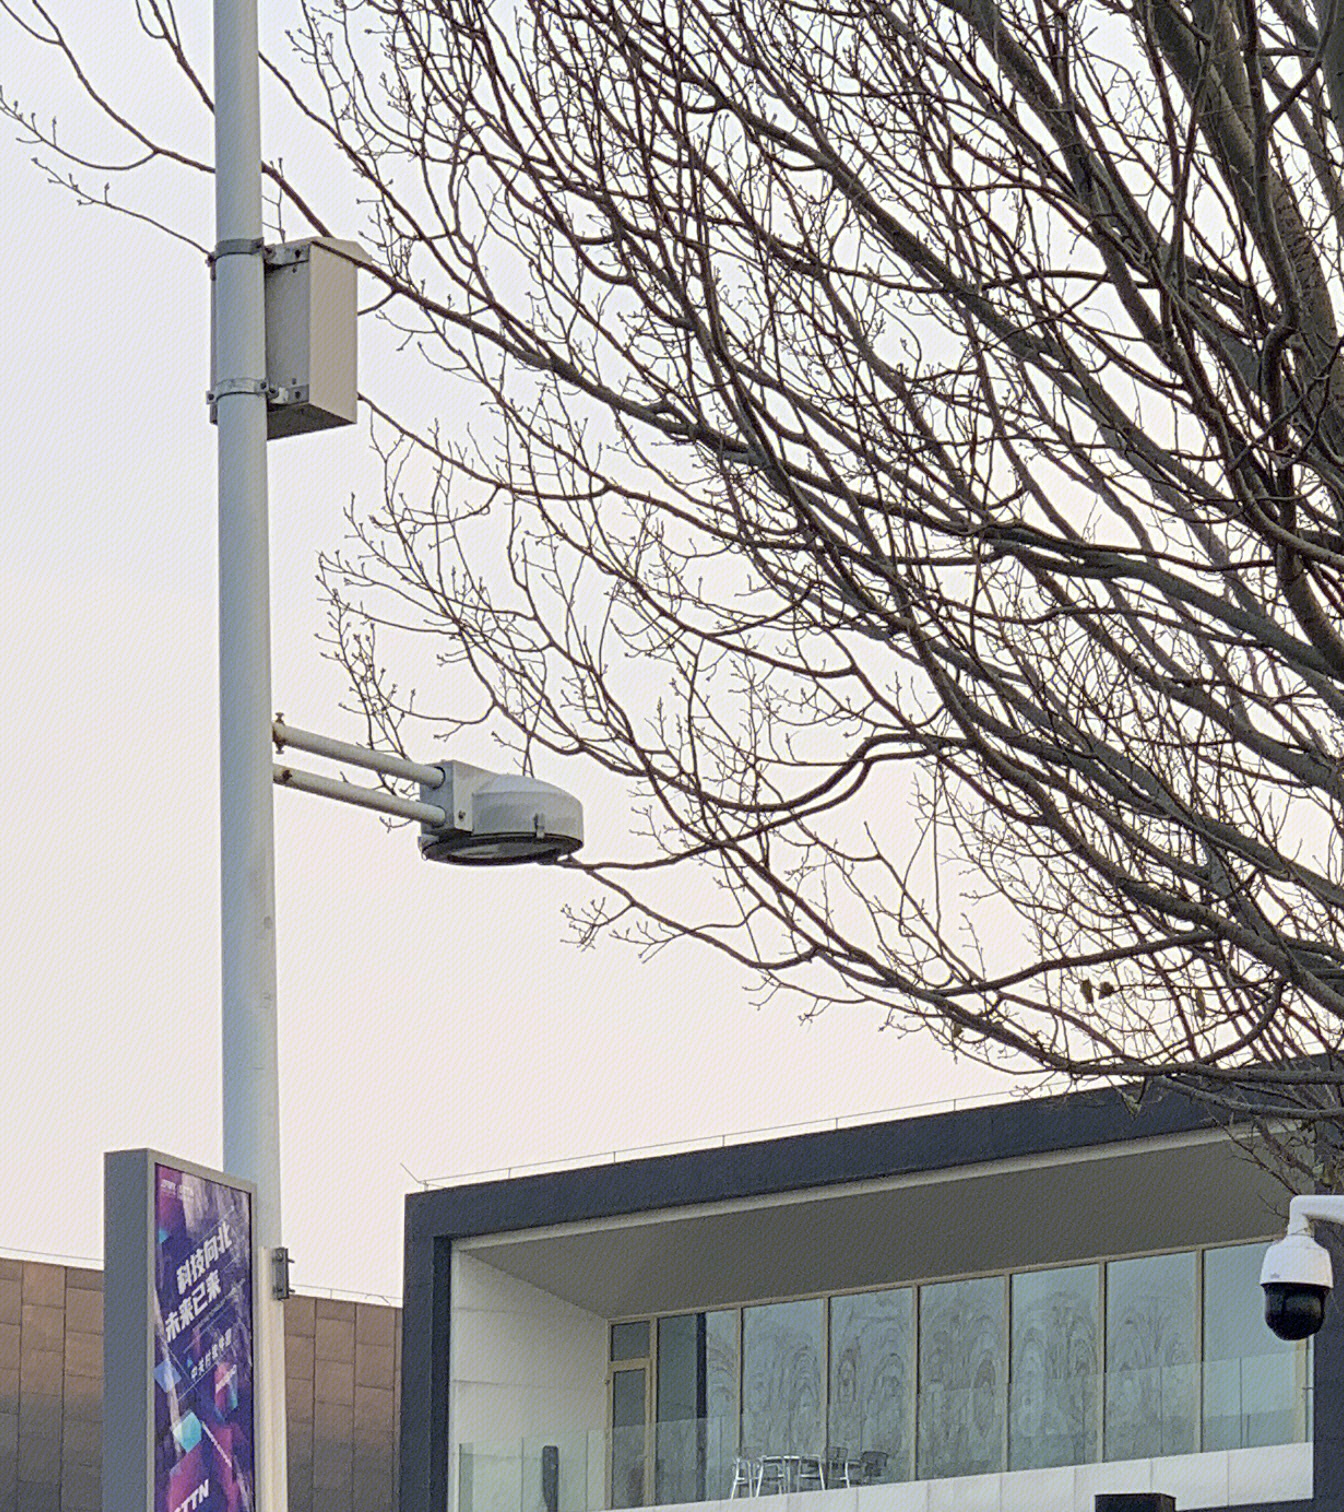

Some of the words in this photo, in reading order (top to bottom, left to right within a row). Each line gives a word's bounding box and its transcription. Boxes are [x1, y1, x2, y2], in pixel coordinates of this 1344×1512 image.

[176, 1220, 233, 1295] 科技向北
[165, 1269, 222, 1343] 未来已来
